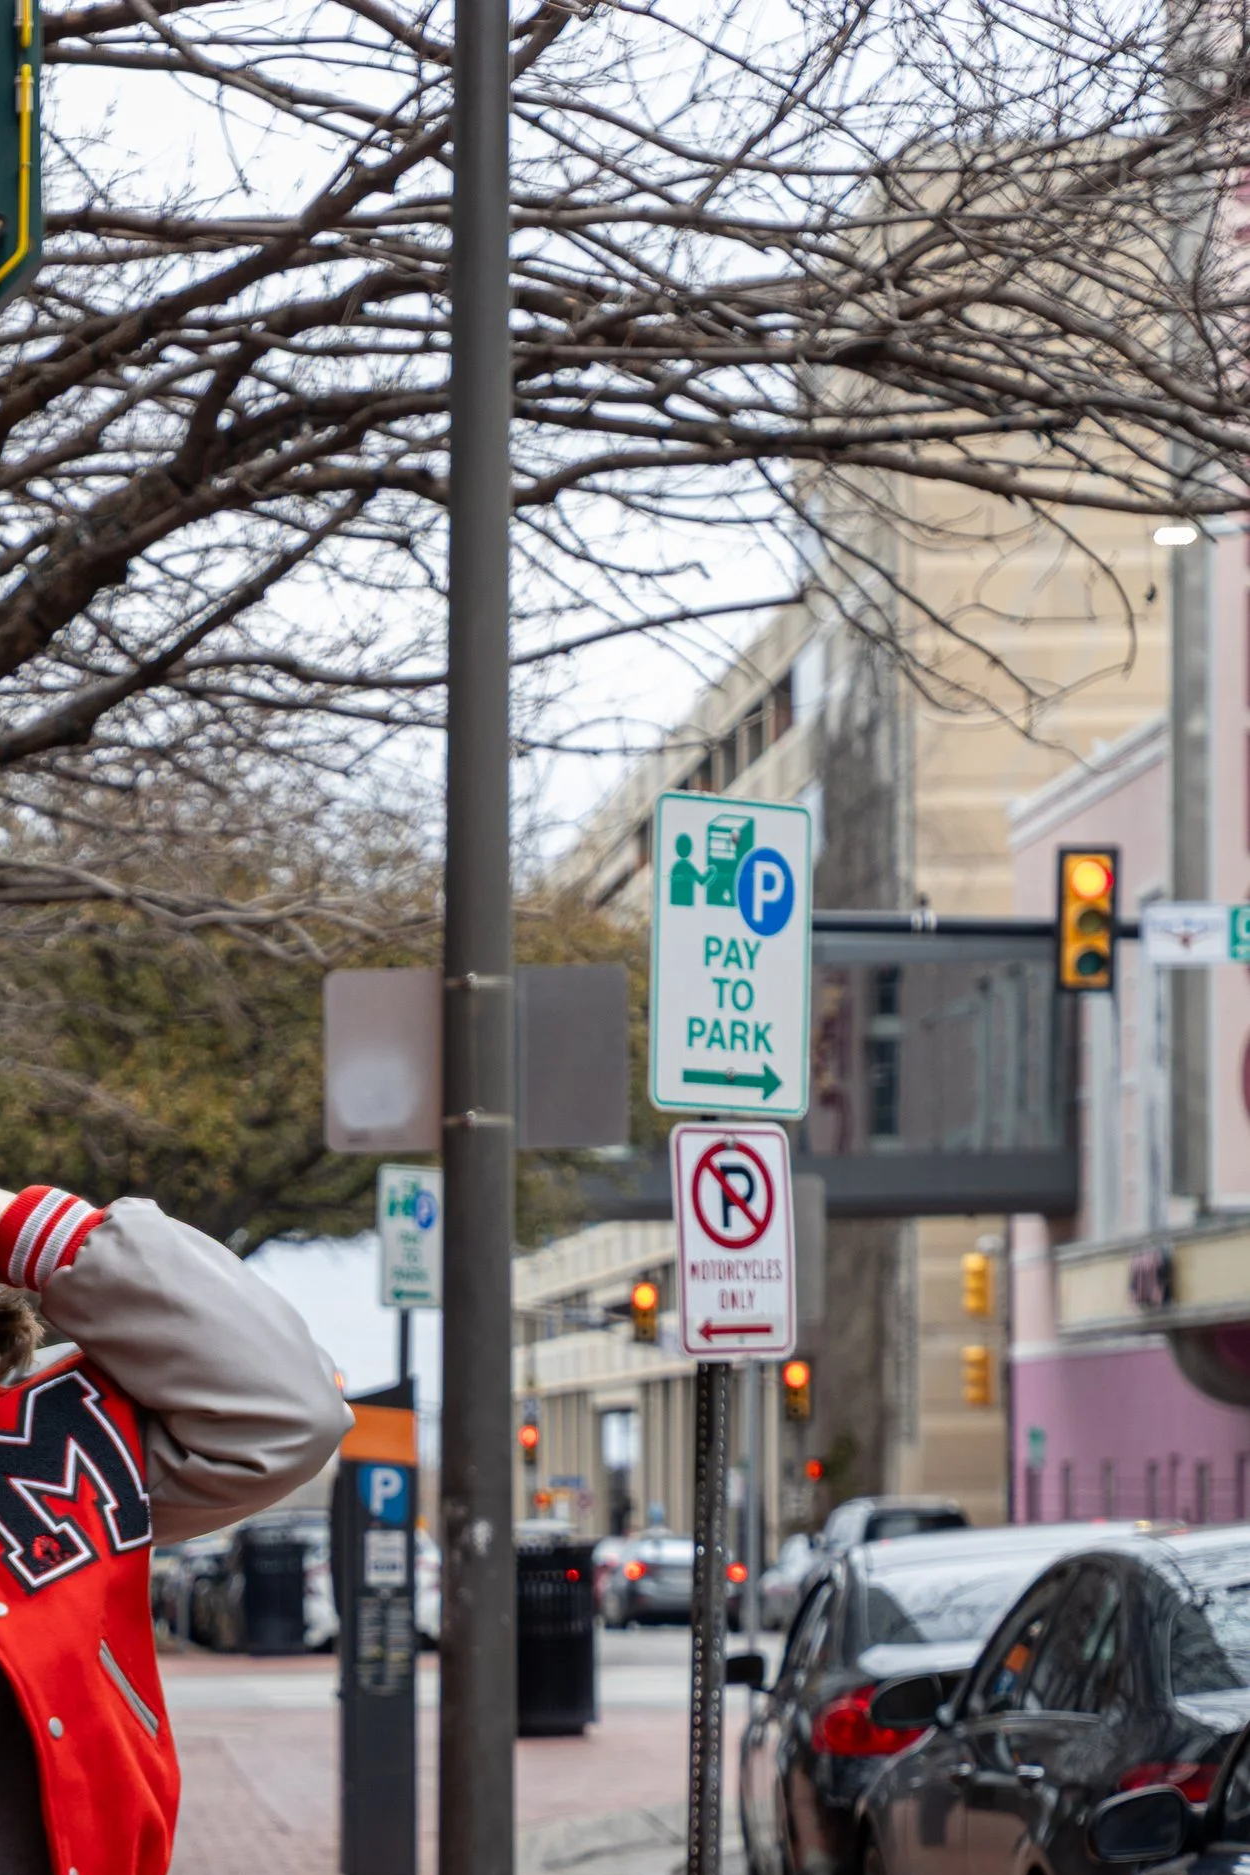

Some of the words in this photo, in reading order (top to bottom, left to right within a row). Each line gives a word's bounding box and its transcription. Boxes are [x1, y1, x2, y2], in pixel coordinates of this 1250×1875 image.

[752, 859, 786, 923] P
[703, 935, 762, 971] PAY
[711, 977, 756, 1012] TO
[686, 1016, 774, 1054] PARK
[690, 1258, 783, 1281] MOTORCYCLES
[718, 1288, 756, 1310] ONLY
[369, 1466, 403, 1517] P
